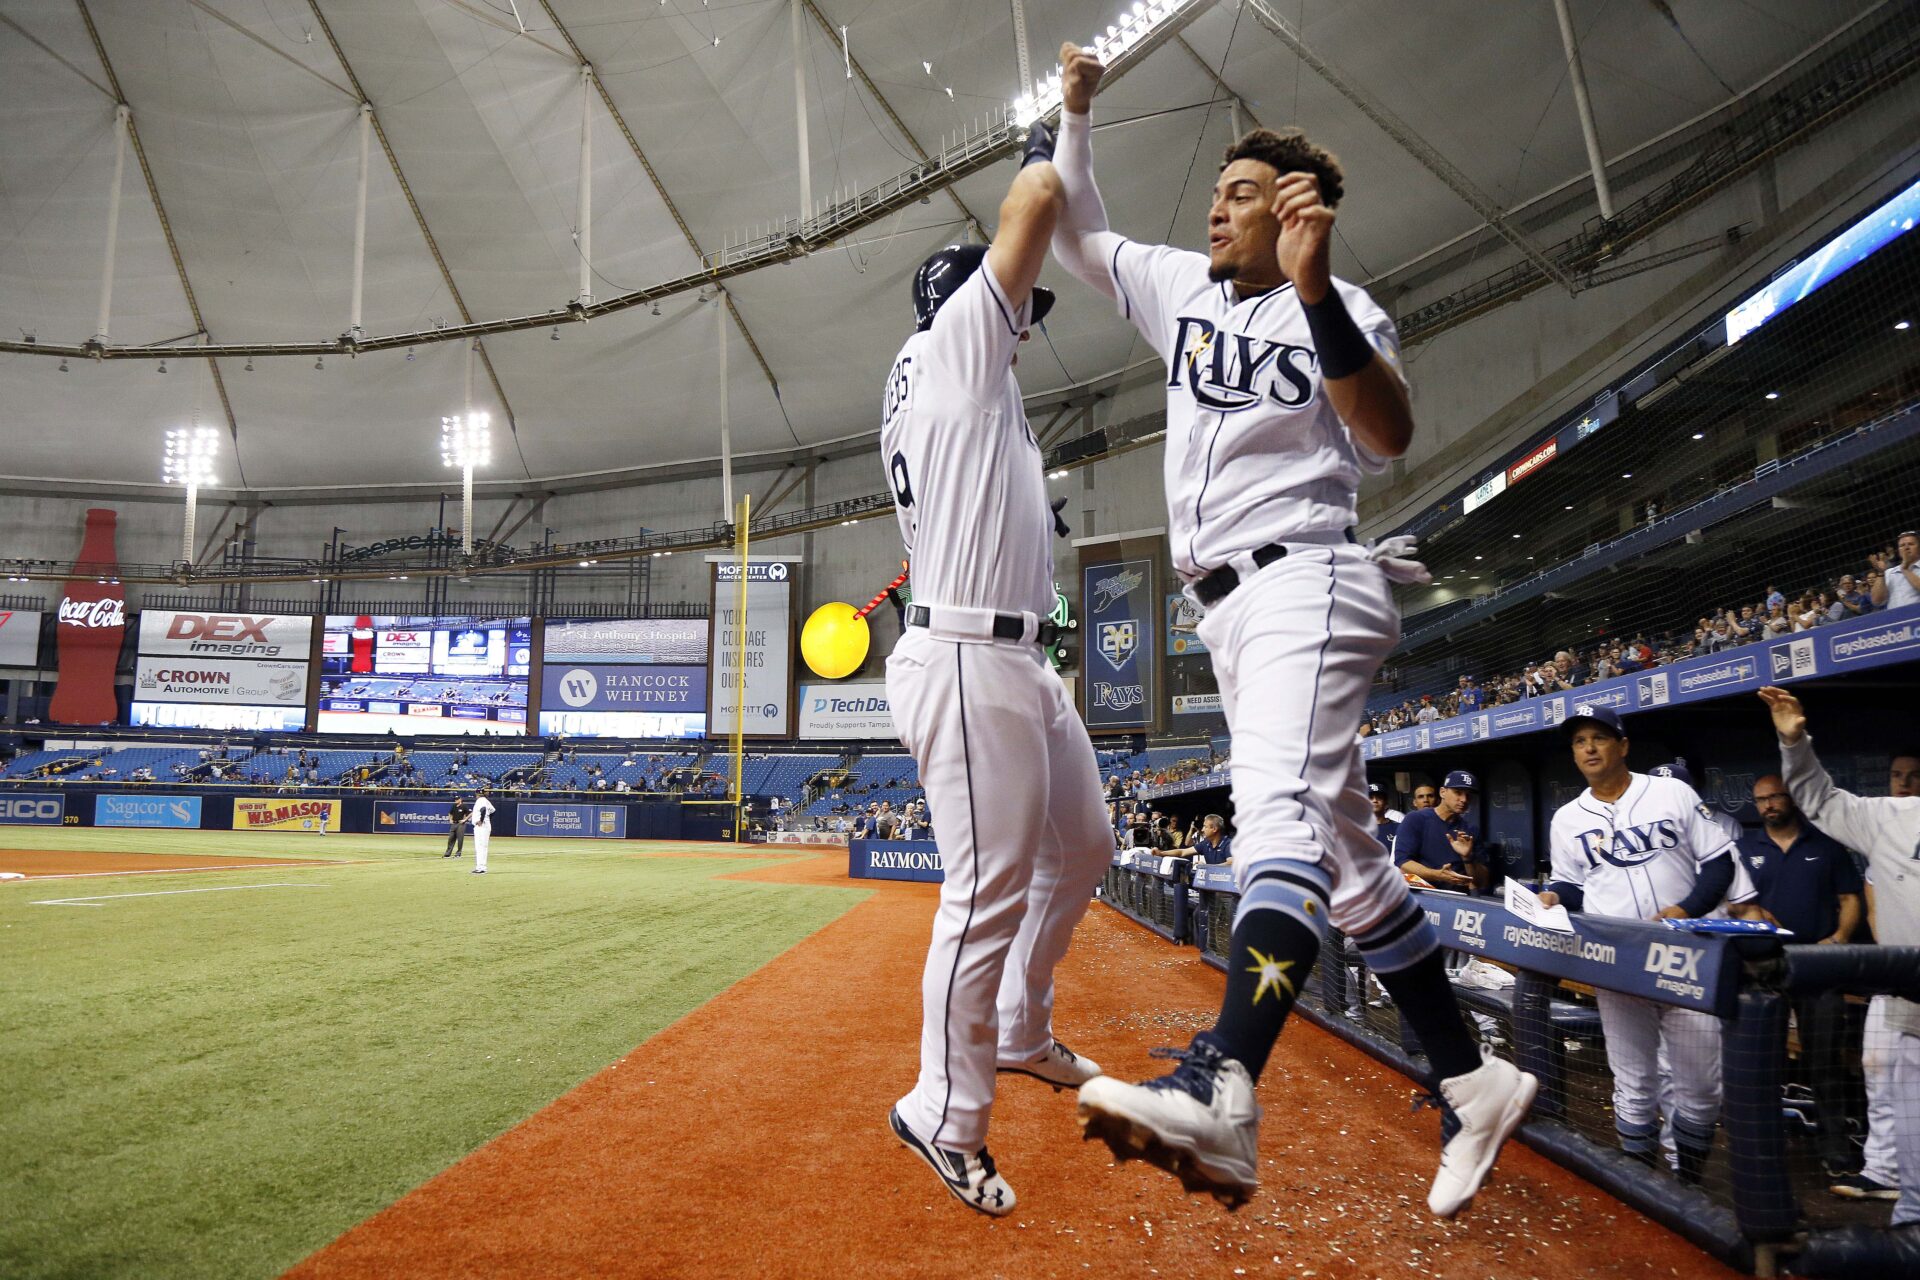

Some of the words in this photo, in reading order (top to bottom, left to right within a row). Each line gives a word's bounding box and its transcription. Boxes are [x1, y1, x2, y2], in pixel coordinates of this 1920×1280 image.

[1168, 317, 1317, 412] RAYS
[59, 597, 124, 627] Coca-Cola
[723, 609, 748, 625] YOU
[166, 614, 275, 643] DEX
[190, 641, 281, 656] imaging
[156, 670, 231, 684] CROWN
[606, 675, 690, 687] HANCOCK
[605, 690, 689, 702] WHITNEY
[1094, 682, 1144, 711] RAYS
[830, 698, 864, 712] Tech
[836, 721, 866, 729] Supports
[868, 721, 891, 729] Tampa
[106, 797, 166, 817] Sagicor
[553, 810, 577, 818] Tampa
[64, 816, 78, 824] 370
[400, 813, 449, 821] MicroLu
[527, 814, 550, 823] TGH
[1574, 819, 1679, 870] RAYS
[1453, 908, 1486, 935] DEX
[1459, 931, 1486, 949] imaging
[1503, 925, 1616, 965] raysbaseball.com
[1644, 942, 1706, 981] DEX
[1656, 975, 1705, 1000] imaging
